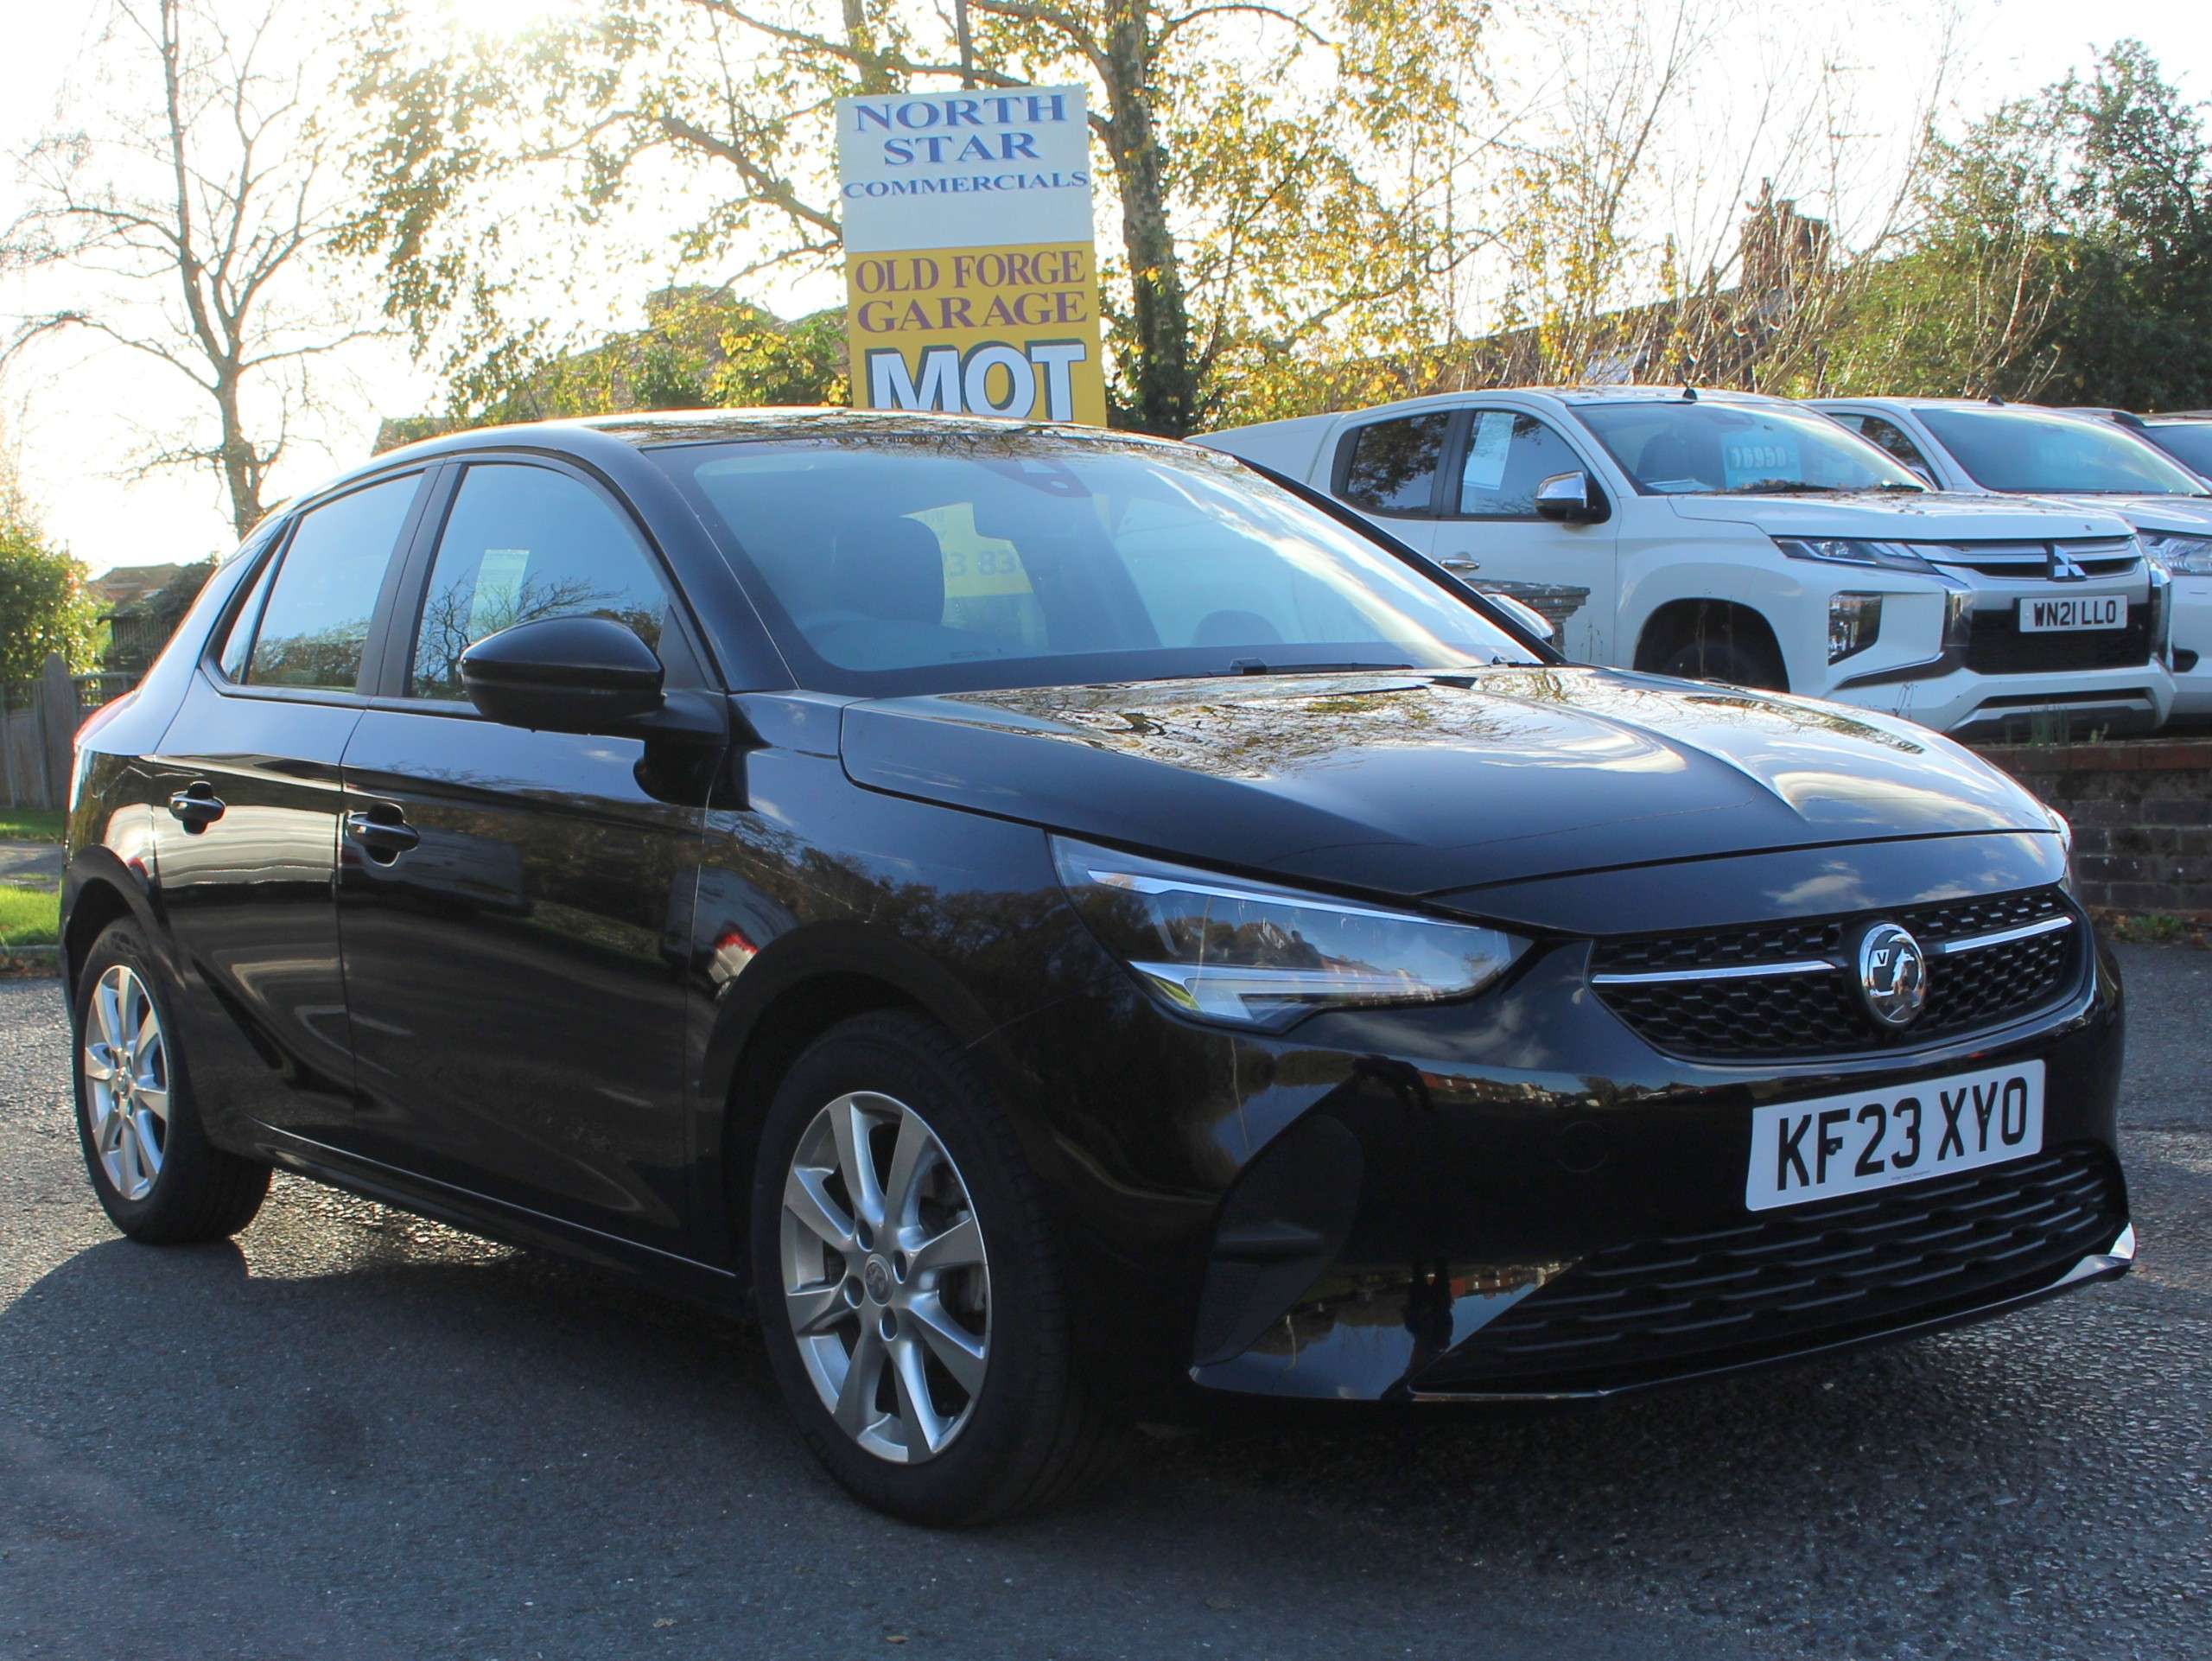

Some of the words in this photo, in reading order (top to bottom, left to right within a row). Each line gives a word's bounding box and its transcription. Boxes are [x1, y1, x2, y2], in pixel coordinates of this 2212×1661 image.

[854, 94, 1068, 131] NORTH
[884, 132, 1044, 166] STAR
[842, 171, 1088, 199] COMMERCIALS
[855, 258, 939, 294] OLD
[953, 250, 1086, 289] FORGE
[857, 291, 1088, 334] GARAGE
[865, 338, 1087, 422] MOT
[2034, 601, 2076, 627] WN21
[2082, 600, 2116, 626] LLO
[1777, 1097, 1923, 1192] KF23
[1936, 1076, 2028, 1162] XYO
